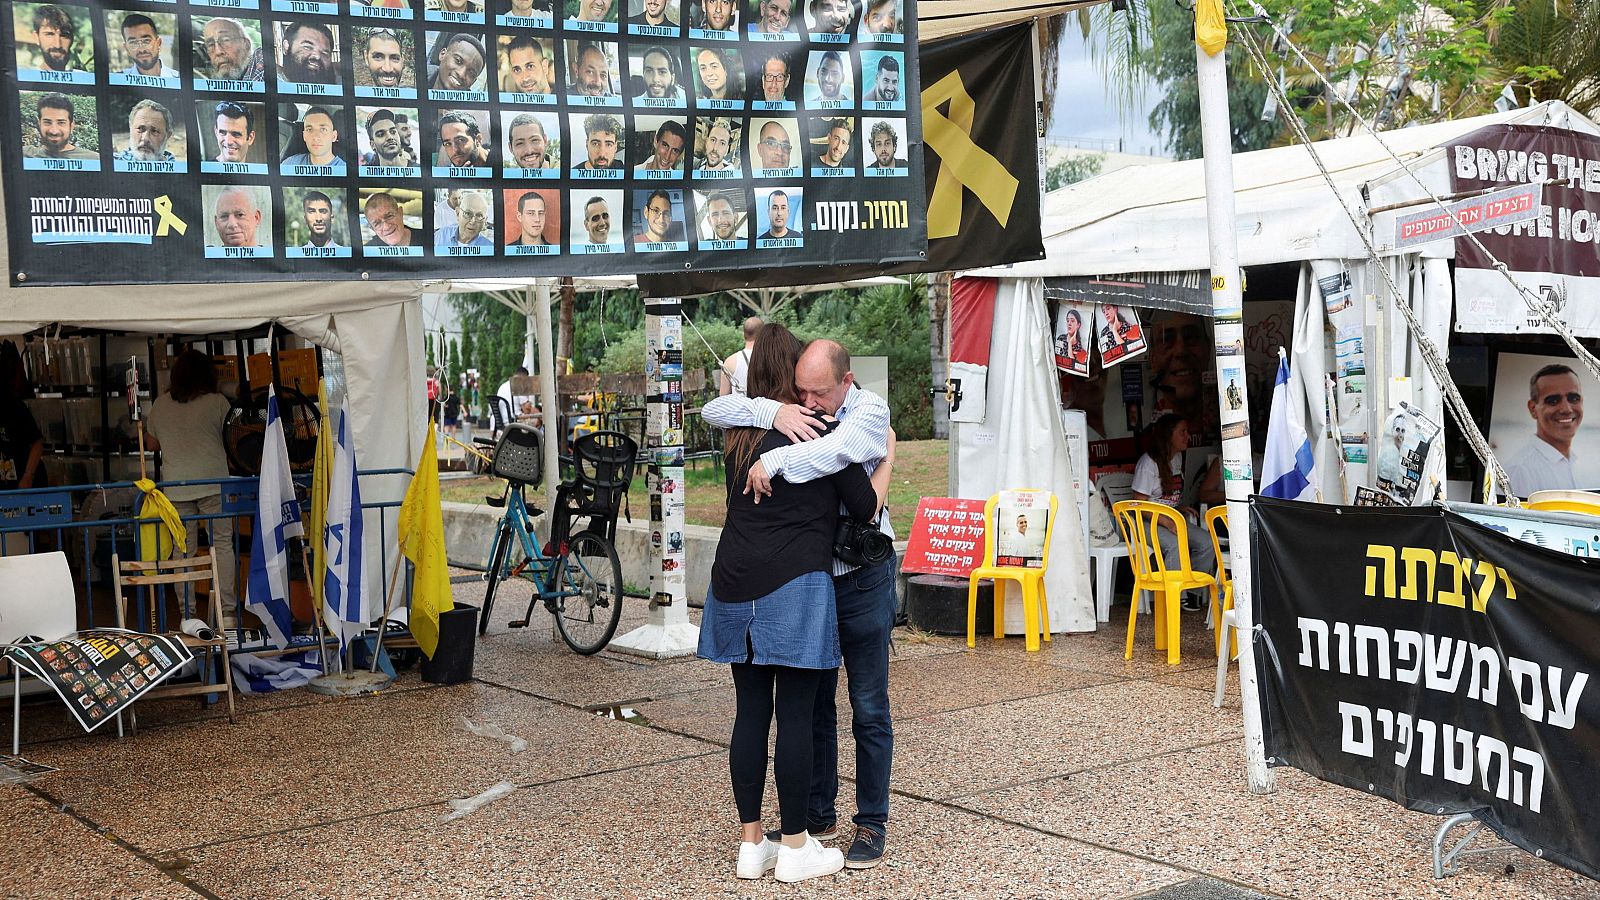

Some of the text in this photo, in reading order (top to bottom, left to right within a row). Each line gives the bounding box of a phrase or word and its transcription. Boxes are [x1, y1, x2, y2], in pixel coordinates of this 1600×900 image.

[291, 2, 320, 12] סהר ברוך
[381, 8, 401, 19] מקסים
[441, 12, 470, 23] אסף חממי
[536, 18, 544, 28] בר
[577, 22, 606, 31] יוסי שרעבי
[663, 27, 671, 36] רום
[62, 72, 72, 81] גיא
[206, 80, 253, 91] אריה זלמנוביץ
[296, 84, 325, 95] איתן הורן
[372, 88, 399, 98] תמיר אדר
[512, 93, 544, 103] אוריאל ברוך
[584, 97, 605, 106] איתן לוי
[68, 160, 82, 170] עידן
[128, 162, 174, 172] אליהו מרגלית
[223, 164, 249, 173] דרור אור
[1455, 145, 1548, 183] BRING
[321, 166, 332, 176] מתן
[367, 168, 384, 176] אוחנה
[401, 168, 414, 178] יוסף
[450, 168, 476, 178] נמרוד כהן
[30, 196, 152, 214] מטה המשפחות להחזרת
[811, 200, 908, 233] נחזיר. נקום.
[1405, 195, 1530, 237] הצילו את החטופים
[31, 216, 153, 236] החטופים והנעדרים
[1558, 207, 1600, 244] NO
[712, 241, 720, 249] פרץ
[225, 248, 254, 258] אילן וייס
[320, 247, 336, 258] ביפין
[400, 247, 409, 255] מני
[448, 246, 480, 256] עמירם קופר
[1297, 616, 1589, 730] עם משפחות
[1338, 700, 1546, 814] החטופים
